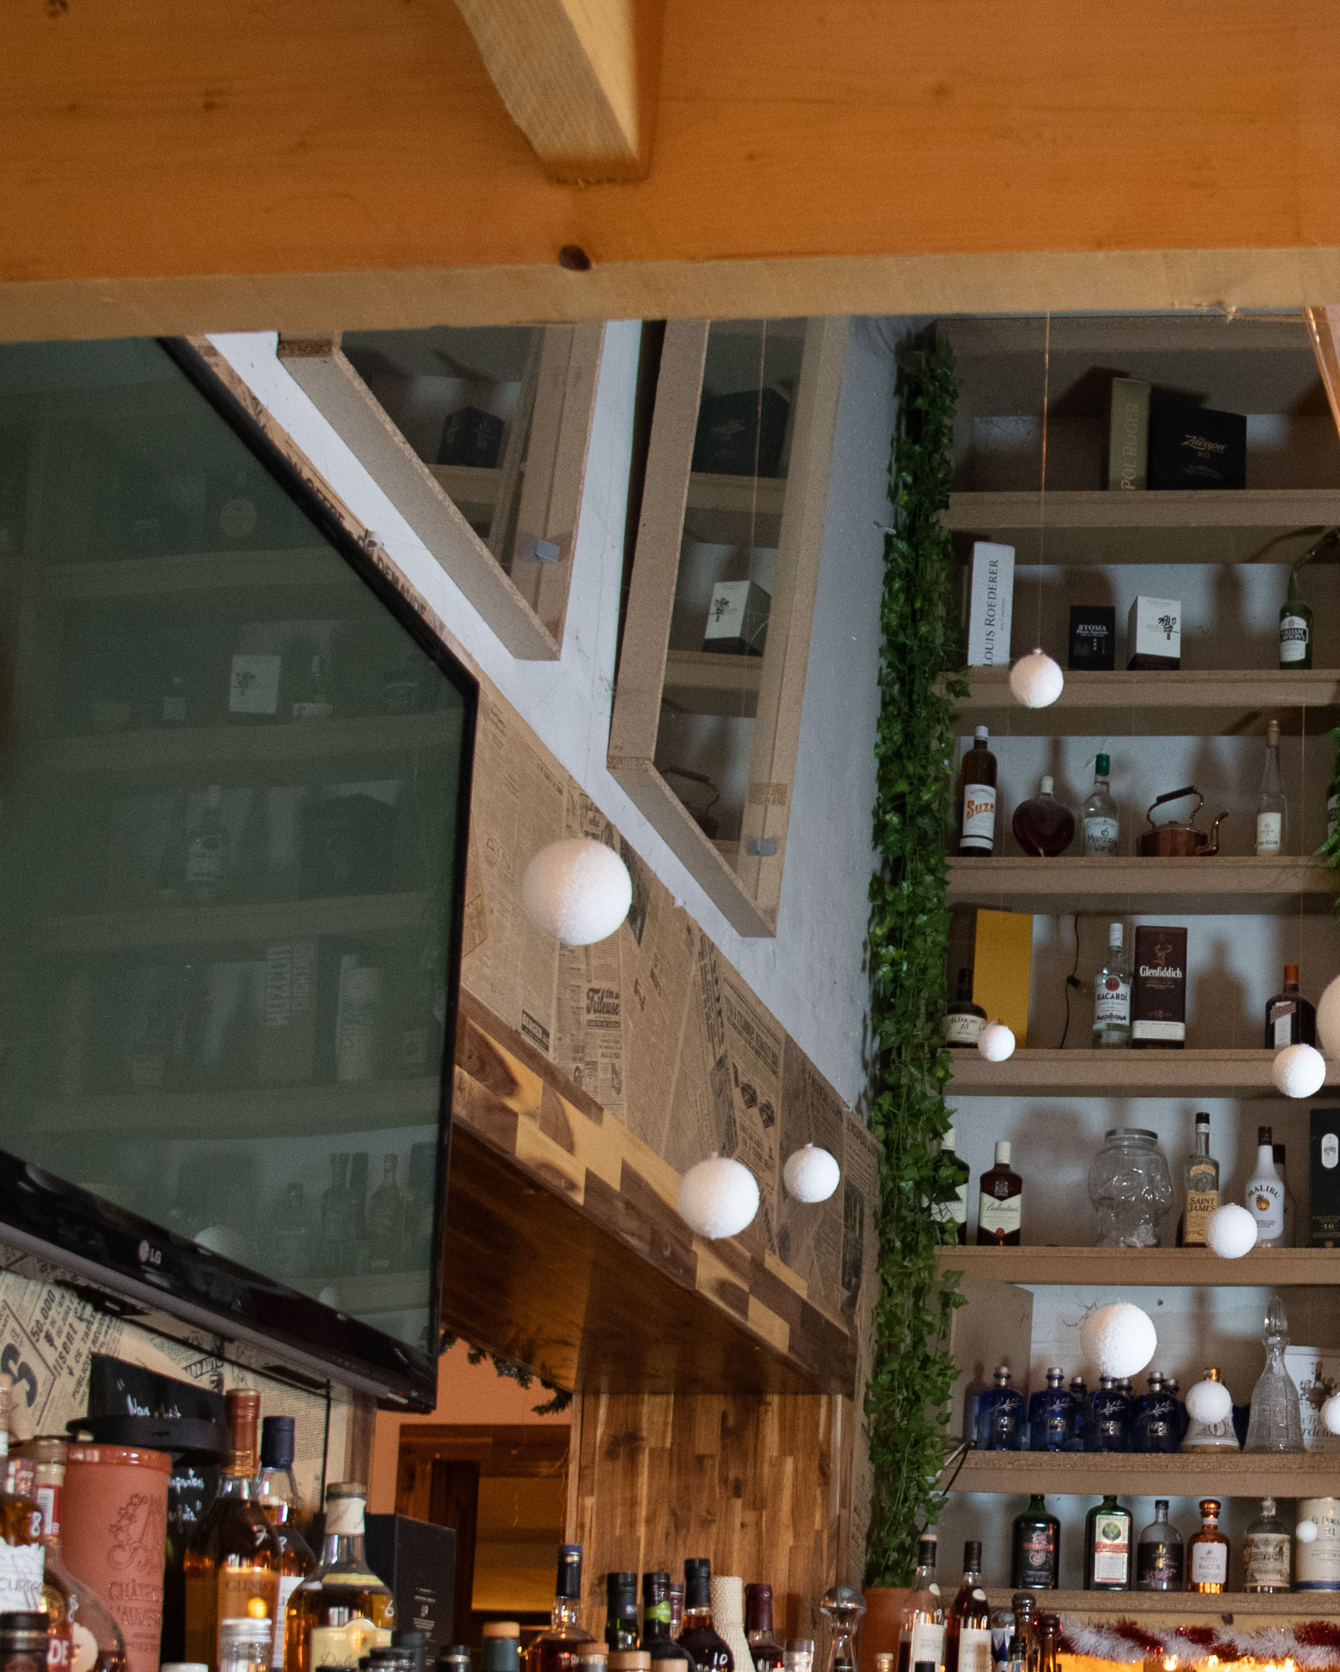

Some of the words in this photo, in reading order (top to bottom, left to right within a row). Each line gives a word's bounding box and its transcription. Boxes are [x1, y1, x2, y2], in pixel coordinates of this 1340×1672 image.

[1122, 402, 1141, 455] ROGER
[1181, 434, 1229, 453] Zacapa
[1120, 458, 1138, 490] POL
[984, 559, 1000, 627] ROEDERER
[1078, 624, 1107, 632] RYOMA
[983, 628, 998, 668] LOUIS
[966, 800, 994, 820] Suze
[1139, 966, 1183, 978] Glenfiddich
[1096, 993, 1128, 1001] BACARDÍ
[1247, 1185, 1280, 1199] MALIBU
[1188, 1205, 1216, 1213] JAMES
[149, 1247, 162, 1265] LG
[30, 1289, 57, 1344] 50.000
[713, 1651, 729, 1667] 10
